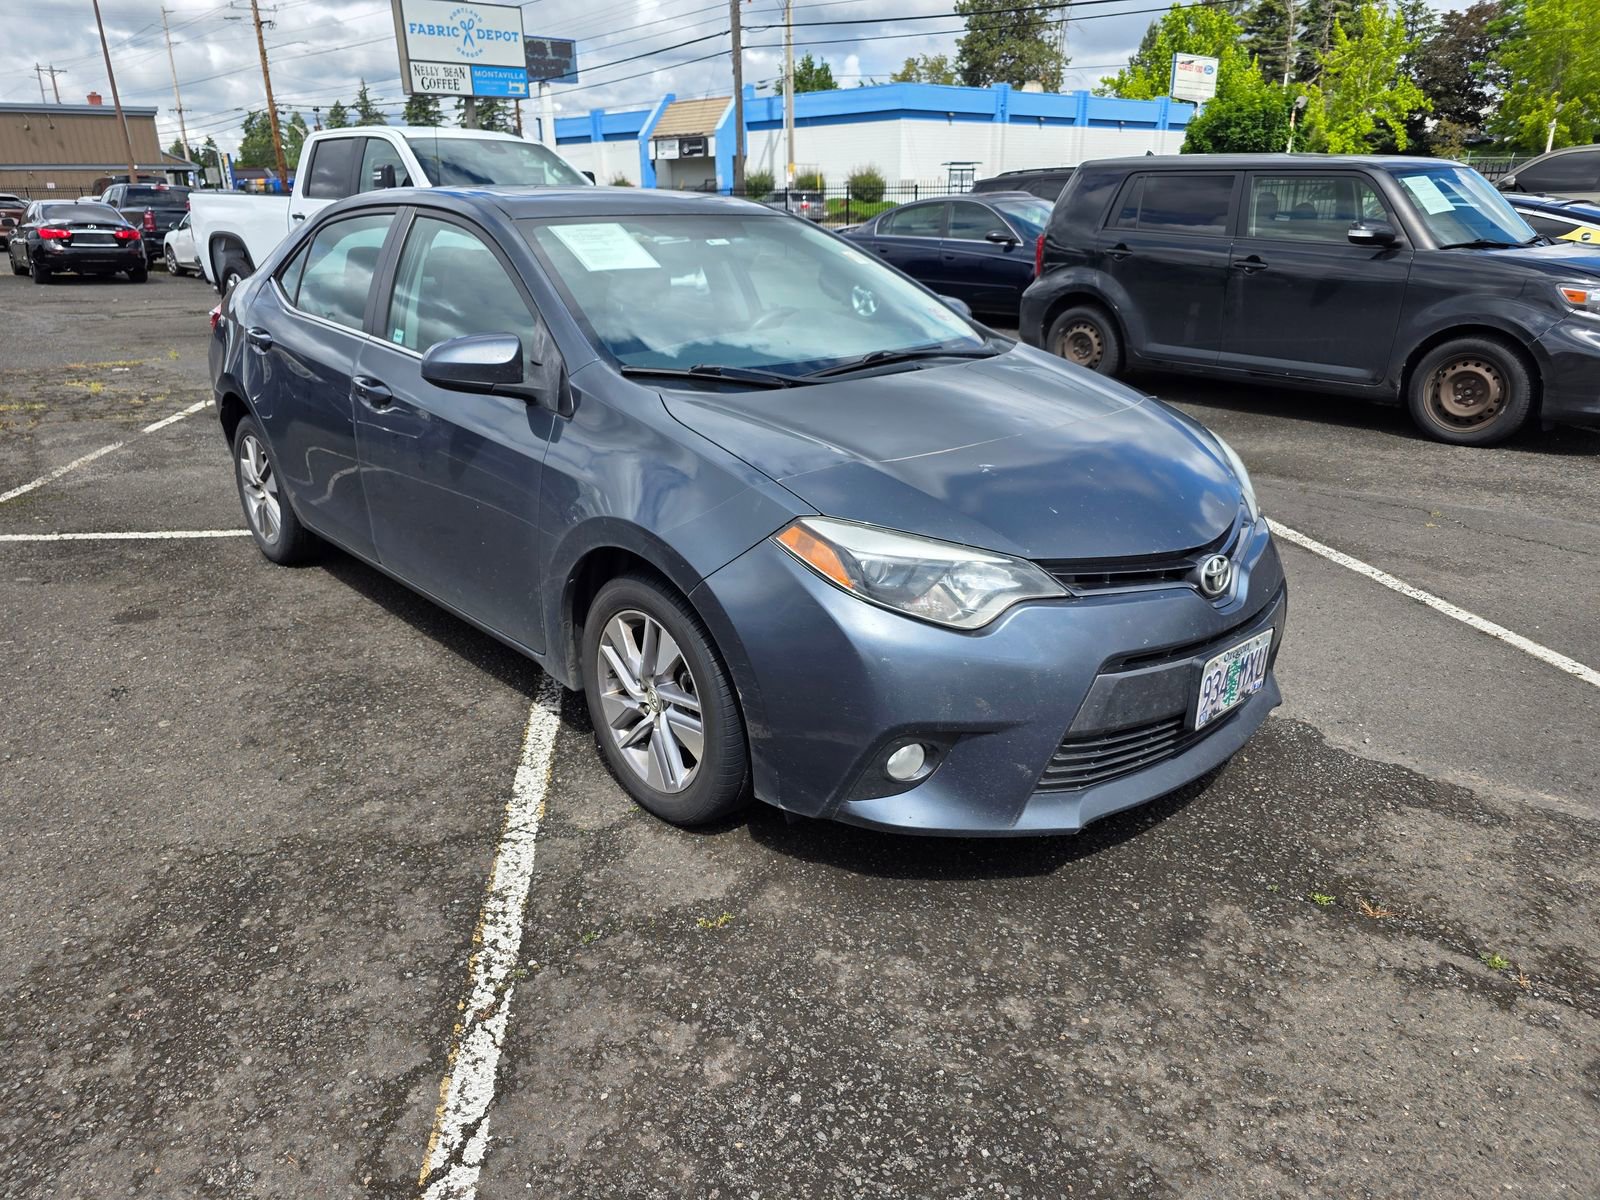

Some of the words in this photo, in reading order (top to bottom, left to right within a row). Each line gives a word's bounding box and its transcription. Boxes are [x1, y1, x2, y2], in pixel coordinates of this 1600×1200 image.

[409, 23, 460, 38] FABRIC
[476, 29, 519, 42] DEPOT
[413, 64, 440, 77] NELLY
[442, 66, 466, 79] BEAN
[474, 70, 524, 80] MONTAVILLA
[421, 77, 461, 91] COFFEE
[1203, 664, 1231, 711] 934
[1236, 645, 1269, 690] MXU
